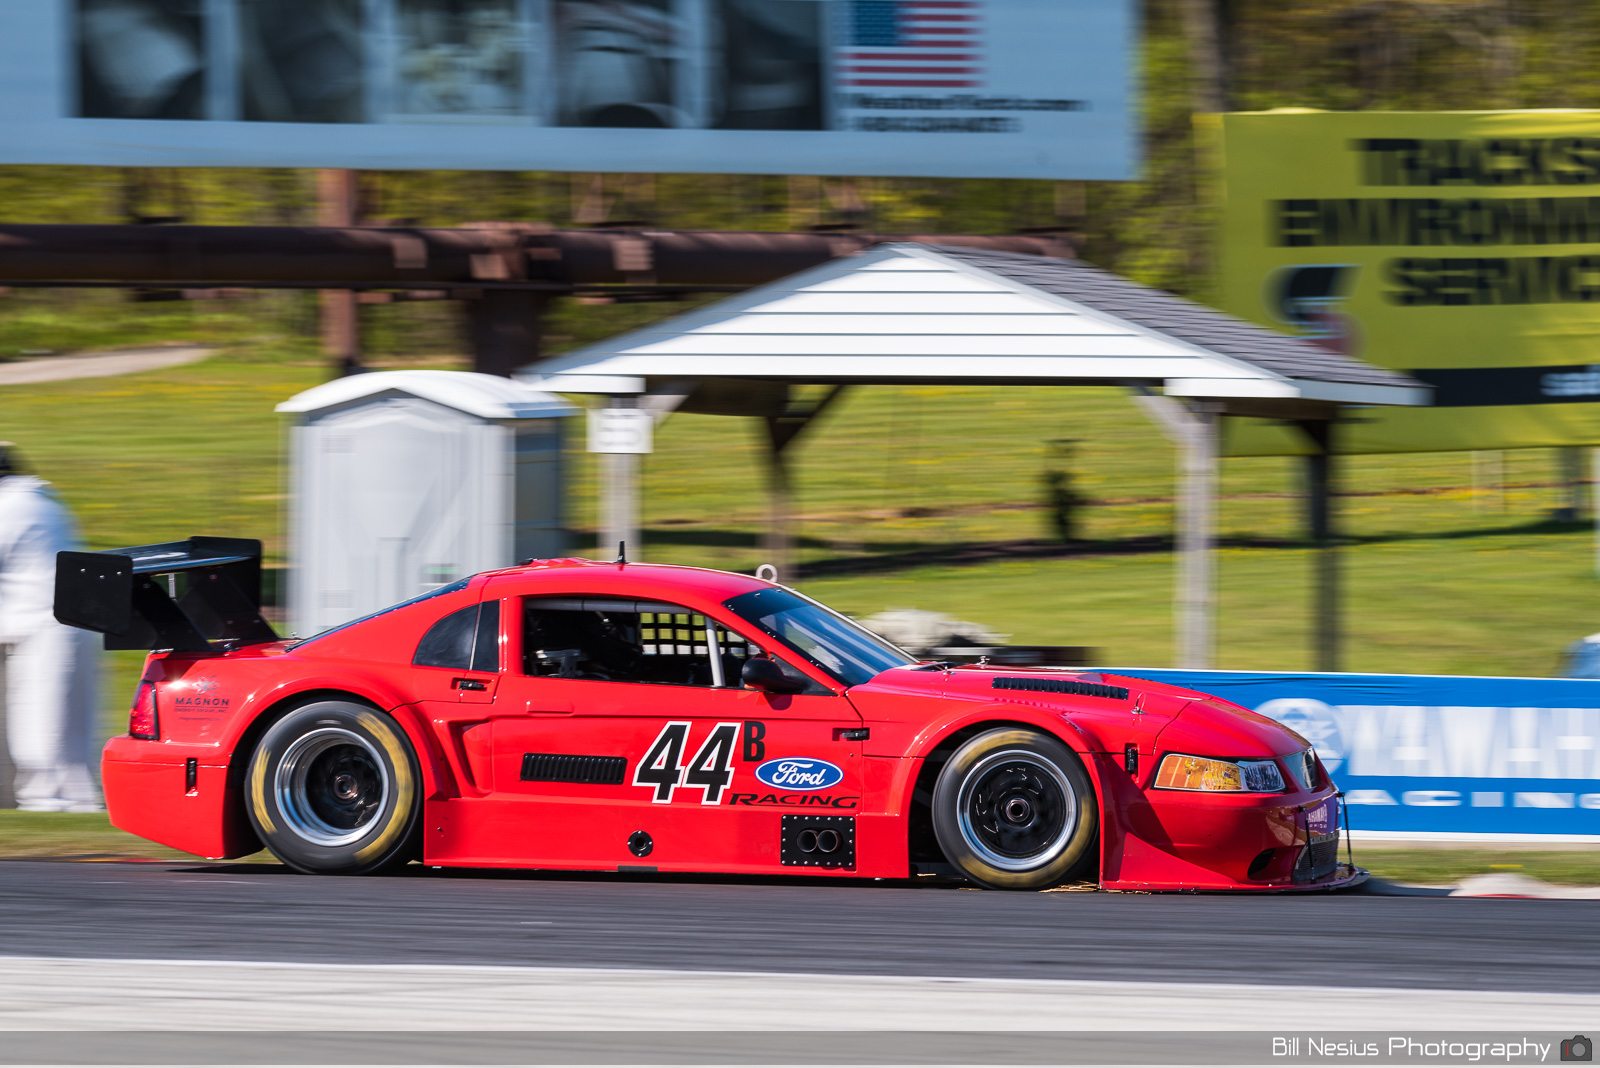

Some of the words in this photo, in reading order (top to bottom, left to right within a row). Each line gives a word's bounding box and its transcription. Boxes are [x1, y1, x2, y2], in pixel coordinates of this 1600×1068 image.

[175, 697, 230, 706] MAGNON
[632, 721, 741, 805] 44
[743, 721, 766, 762] B
[772, 761, 828, 786] Ford
[729, 793, 860, 808] RACING
